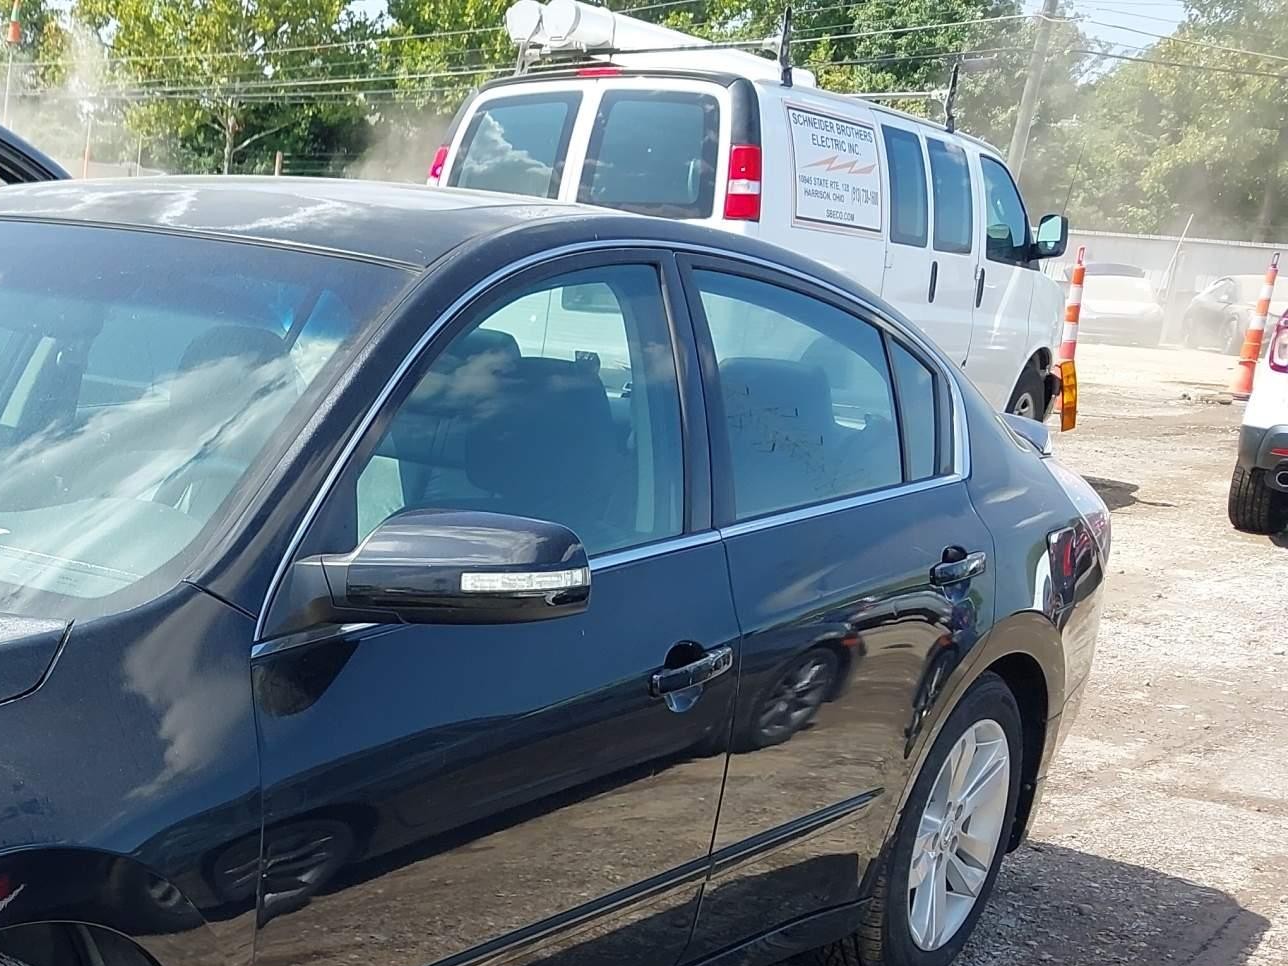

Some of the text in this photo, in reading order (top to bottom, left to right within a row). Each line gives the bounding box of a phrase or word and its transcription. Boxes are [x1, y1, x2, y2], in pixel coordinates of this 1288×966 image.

[792, 113, 872, 143] SCHNEIDER BROTHERS
[811, 134, 863, 157] ELECTRIC INC.
[813, 177, 829, 188] STATE
[832, 192, 845, 203] OHIO
